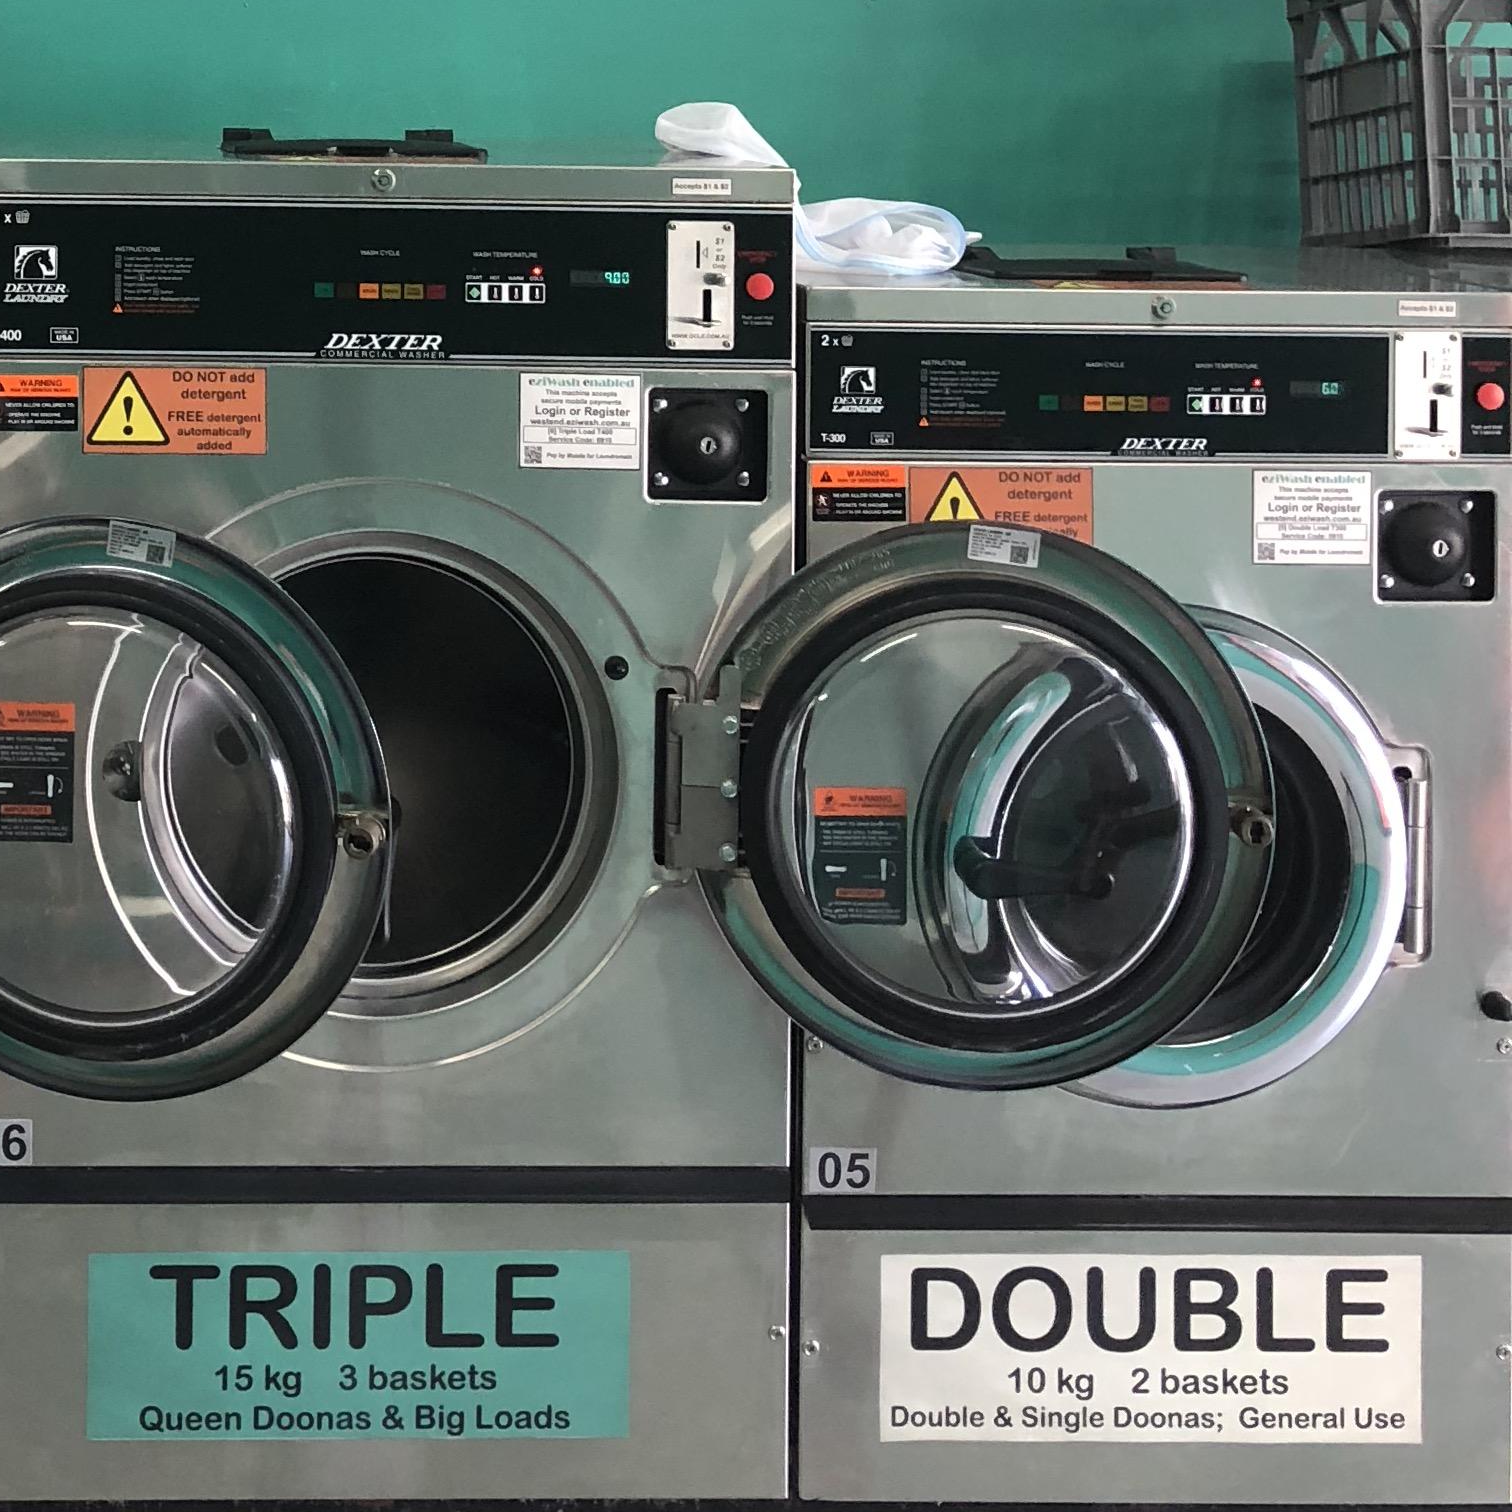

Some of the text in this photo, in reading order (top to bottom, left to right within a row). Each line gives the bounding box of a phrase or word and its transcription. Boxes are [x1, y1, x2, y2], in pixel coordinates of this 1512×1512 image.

[324, 333, 444, 350] DEXTER
[821, 335, 838, 346] 2 x
[320, 350, 394, 358] COMMERCIAL
[172, 371, 255, 383] DO NOT add
[181, 388, 247, 402] detergent
[833, 397, 882, 405] DEXTER
[168, 411, 261, 424] FREE detergent
[535, 405, 565, 417] Login
[585, 407, 630, 418] Register
[177, 426, 252, 440] automatically
[197, 440, 232, 451] added
[1120, 438, 1208, 450] DEXTER
[999, 472, 1081, 484] DO NOT add
[1008, 489, 1072, 501] detergent
[817, 1152, 871, 1188] 05
[149, 1263, 560, 1350] TRIPLE
[910, 1266, 1389, 1353] DOUBLE
[215, 1364, 497, 1397] 15 kg 3 baskets
[1007, 1367, 1289, 1400] 10 kg 2 baskets
[139, 1404, 570, 1436] Queen Doonas & Big Loads
[890, 1407, 1405, 1434] Double & Single Doonas; General Use
